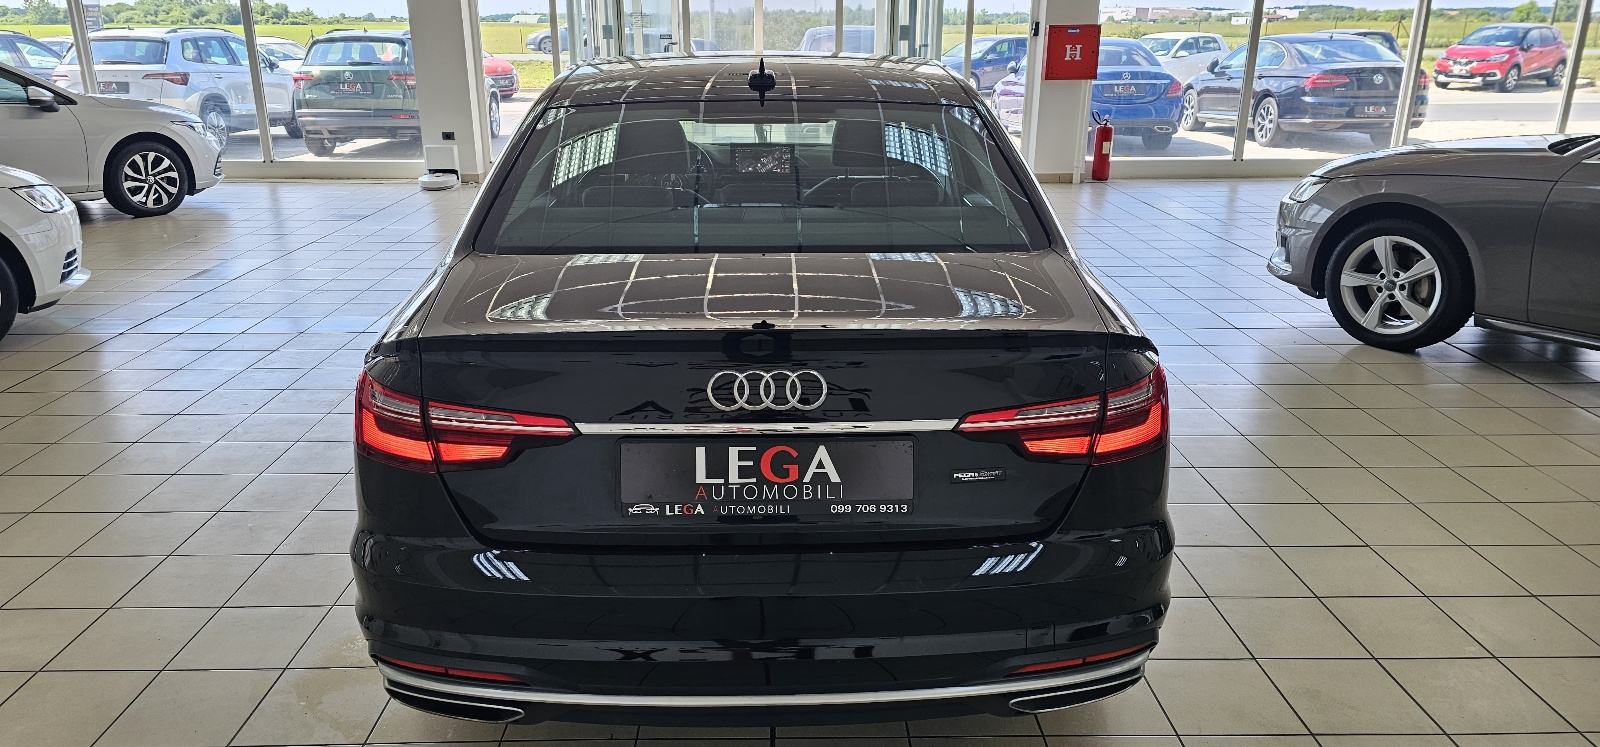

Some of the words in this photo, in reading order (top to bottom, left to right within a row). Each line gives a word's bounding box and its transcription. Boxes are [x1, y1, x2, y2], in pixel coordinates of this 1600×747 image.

[340, 82, 363, 91] LEGA
[1114, 85, 1137, 93] LEGA
[1364, 105, 1387, 113] LEGA
[695, 445, 841, 484] LEGA
[695, 485, 844, 500] AUTOMOBILI
[666, 504, 705, 516] LEGA
[713, 504, 790, 515] AUTOMOBILI
[830, 504, 852, 514] 099
[855, 504, 877, 514] 706
[879, 504, 908, 514] 9313
